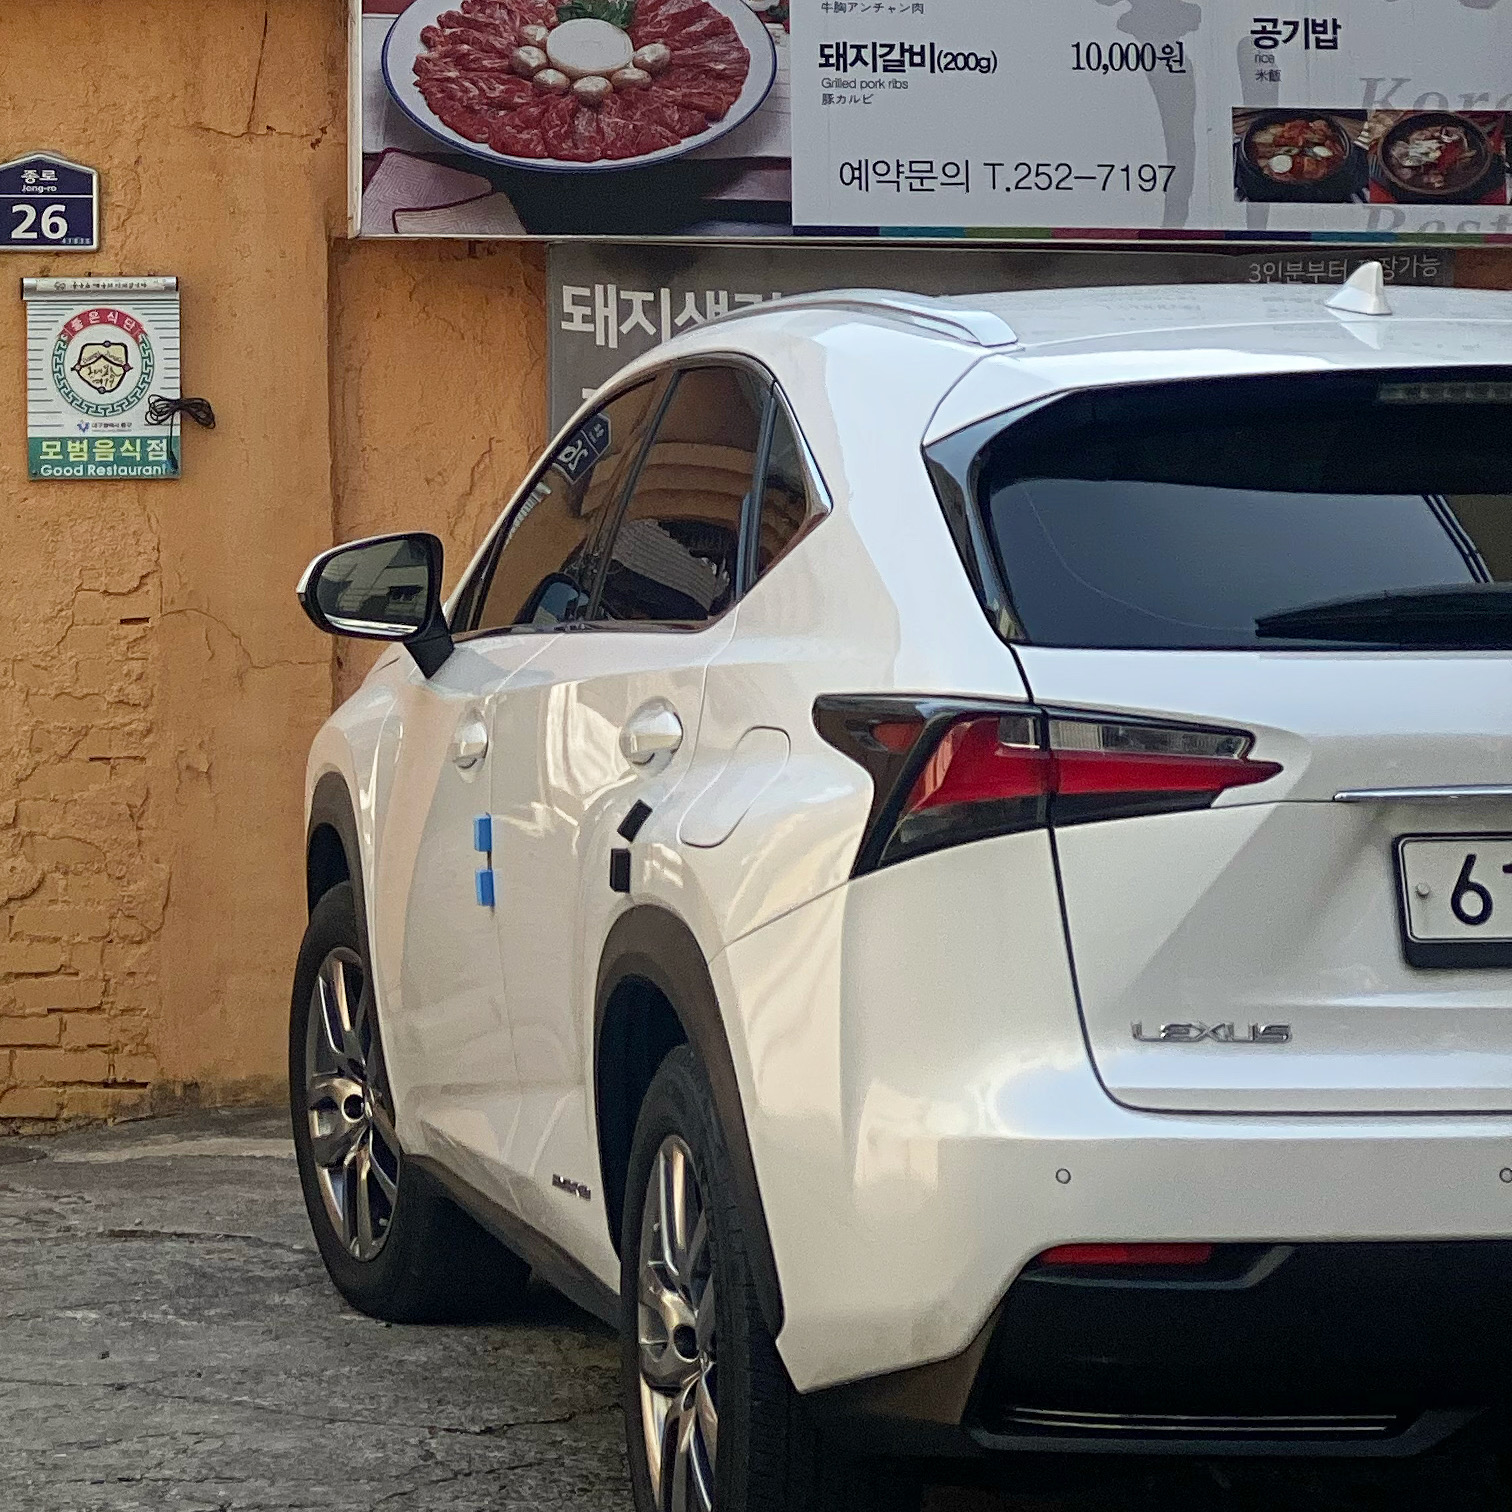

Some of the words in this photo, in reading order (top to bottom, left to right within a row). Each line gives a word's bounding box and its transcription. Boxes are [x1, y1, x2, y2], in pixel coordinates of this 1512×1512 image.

[1250, 17, 1342, 50] 공기밥
[818, 41, 998, 74] 돼지갈비(200g)
[1071, 41, 1186, 75] 10,000원
[1254, 52, 1275, 64] rice
[821, 78, 857, 89] Grilled
[860, 79, 886, 91] pork
[888, 78, 909, 90] ribs
[20, 169, 58, 184] 종로
[839, 159, 970, 194] 예약문의
[983, 161, 1177, 193] T.252-7197
[21, 184, 58, 194] Jong-ro
[11, 204, 68, 240] 26
[1358, 254, 1441, 281] 장가능
[39, 439, 168, 462] 모범음식점
[40, 464, 84, 476] Good
[87, 464, 167, 477] Restaurant
[1131, 1021, 1292, 1043] LEXUS
